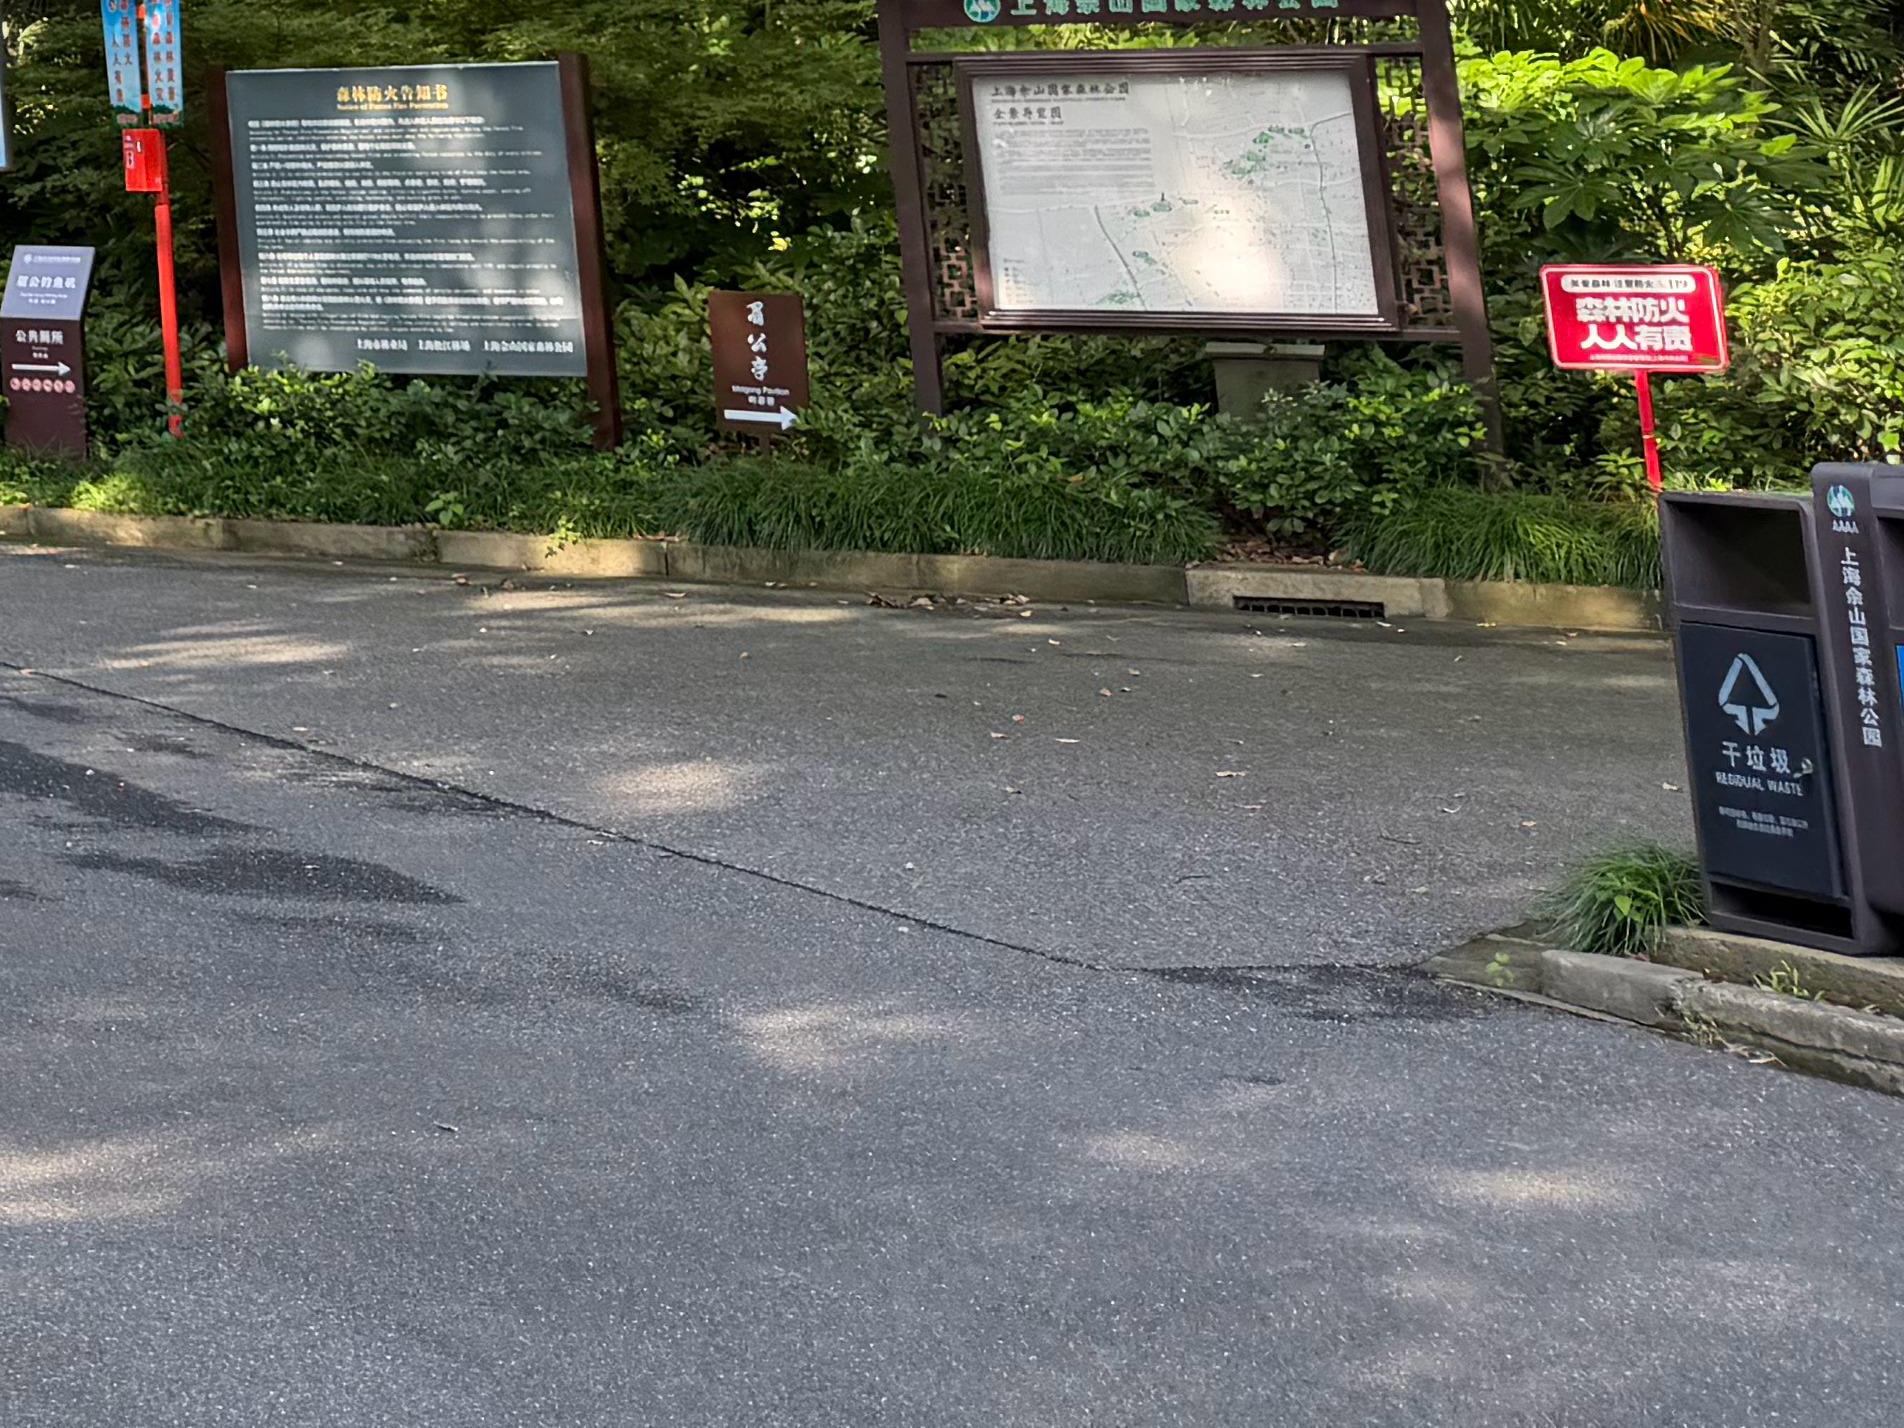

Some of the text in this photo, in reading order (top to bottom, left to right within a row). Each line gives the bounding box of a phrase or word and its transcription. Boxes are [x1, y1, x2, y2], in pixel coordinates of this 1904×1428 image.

[1576, 297, 1690, 323] 森林防火
[1580, 324, 1693, 351] 人人有责
[1841, 546, 1882, 747] 上海佘山国家森林公园
[1722, 740, 1791, 774] 干垃圾
[1767, 780, 1803, 797] WASTE
